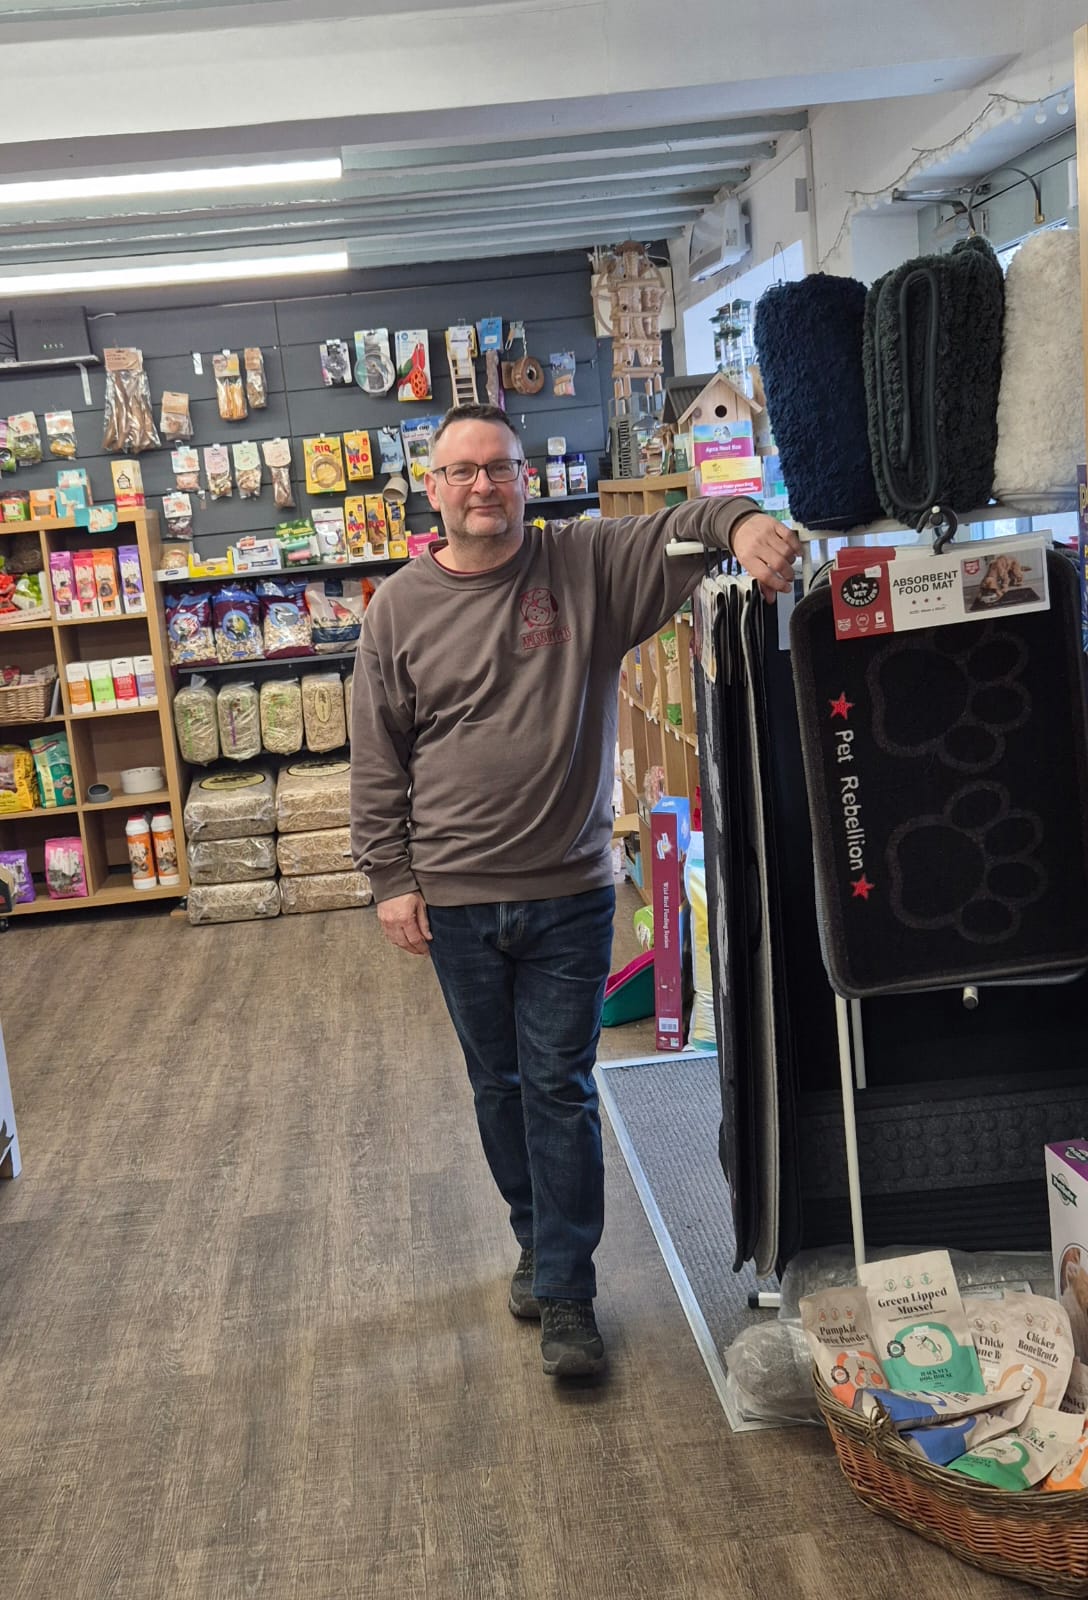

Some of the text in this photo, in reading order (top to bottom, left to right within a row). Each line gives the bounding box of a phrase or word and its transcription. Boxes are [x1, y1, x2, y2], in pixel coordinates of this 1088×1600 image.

[314, 445, 330, 453] RIO
[348, 453, 369, 464] RIO
[347, 523, 365, 532] RIO
[368, 520, 386, 528] RIO
[892, 570, 958, 588] ABSORBENT
[853, 590, 867, 598] PET
[899, 580, 954, 596] FOOD MAT
[843, 589, 878, 606] REBELLION
[835, 729, 865, 871] Pet Rebellion
[877, 1297, 909, 1308] Green
[910, 1287, 948, 1302] Lipped
[897, 1301, 934, 1315] Mussel
[839, 1333, 870, 1344] Powder
[1026, 1330, 1056, 1350] Chicken
[1018, 1339, 1037, 1354] Bone
[1036, 1346, 1060, 1364] Broth
